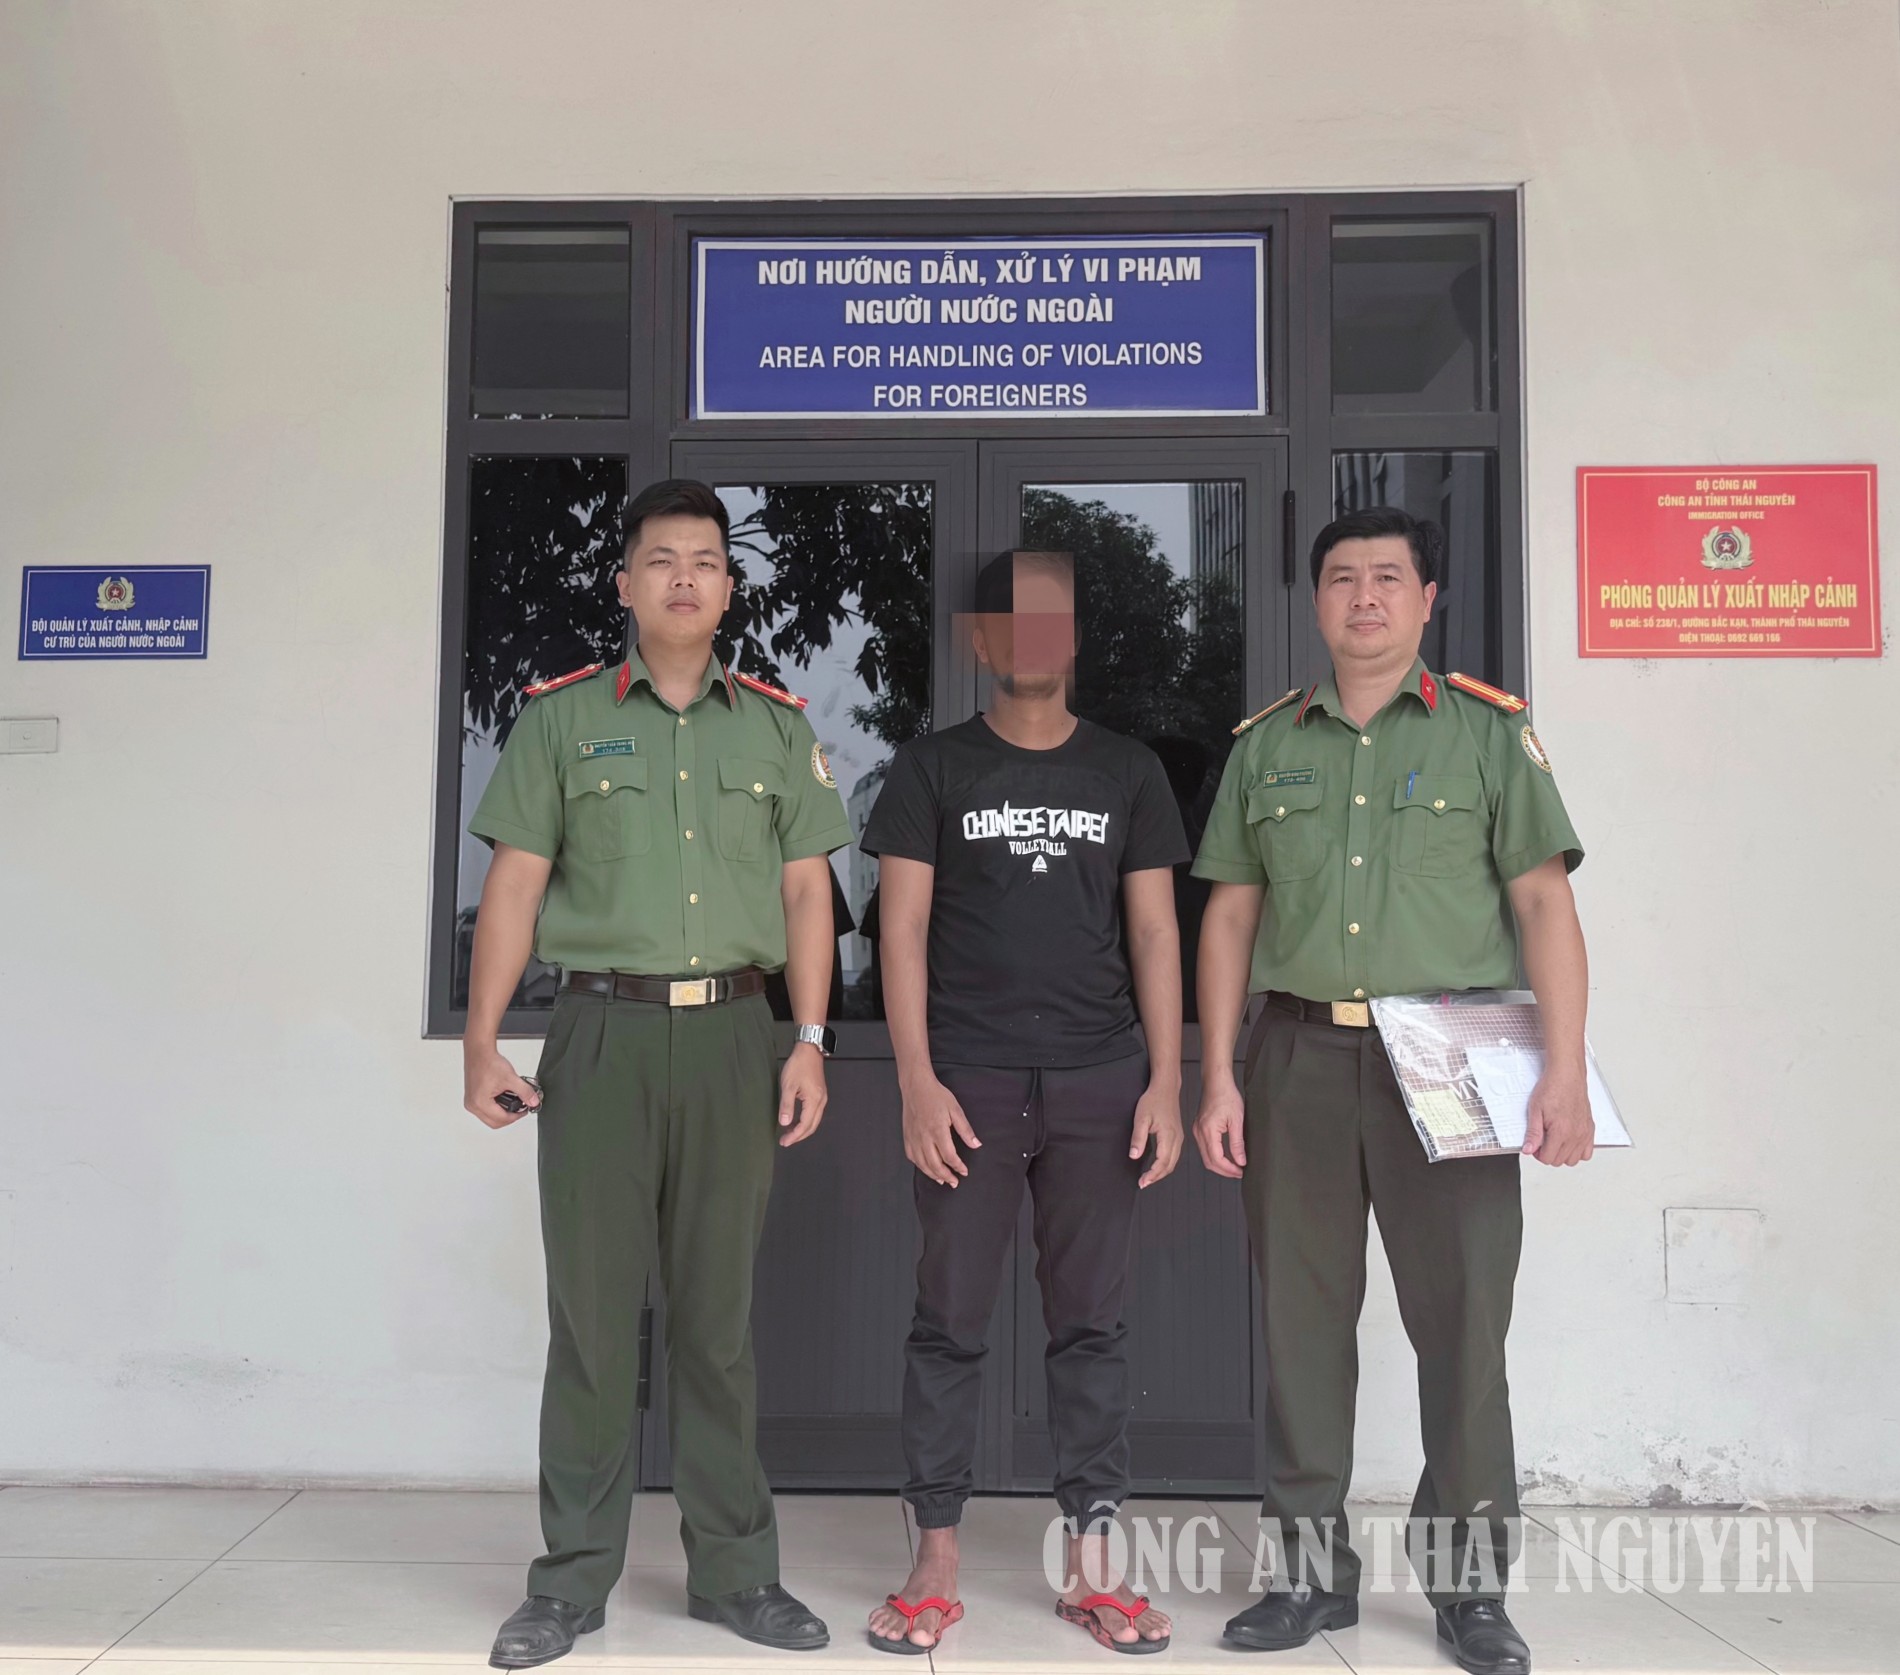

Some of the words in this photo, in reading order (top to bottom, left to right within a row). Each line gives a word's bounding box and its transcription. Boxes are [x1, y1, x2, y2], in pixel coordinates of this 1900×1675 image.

[758, 259, 806, 284] NƠI
[815, 255, 911, 284] HƯỚNG
[920, 251, 987, 287] DẪN,
[996, 251, 1038, 283] XỬ
[1043, 253, 1073, 282] LÝ
[1084, 258, 1108, 282] VI
[1118, 257, 1201, 288] PHẠM
[845, 296, 931, 324] NGƯỜI
[941, 293, 1018, 323] NƯỚC
[1027, 292, 1113, 323] NGOÀI
[759, 346, 824, 368] AREA
[834, 346, 881, 367] FOR
[889, 344, 1013, 367] HANDLING
[1021, 344, 1054, 366] OF
[1060, 342, 1202, 365] VIOLATIONS
[874, 385, 921, 407] FOR
[930, 384, 1087, 407] FOREIGNERS
[1696, 478, 1709, 493] BỘ
[1712, 478, 1740, 491] CÔNG
[1742, 480, 1756, 490] AN
[1658, 495, 1685, 506] CÔNG
[1688, 496, 1704, 506] AN
[1707, 492, 1728, 506] TỈNH
[1730, 493, 1752, 506] THÁI
[1755, 494, 1795, 505] NGUYÊN
[1689, 512, 1737, 520] IMMIGRATION
[1740, 511, 1764, 519] OFFICE
[1601, 580, 1652, 609] PHÒNG
[1657, 577, 1699, 611] QUẢN
[1703, 579, 1721, 608] LÝ
[1725, 576, 1765, 608] XUẤT
[1768, 579, 1810, 613] NHẬP
[1815, 576, 1857, 608] CẢNH
[32, 618, 47, 634] ĐỘI
[50, 616, 74, 632] QUẢN
[77, 618, 88, 631] LÝ
[90, 616, 113, 631] XUẤT
[145, 617, 170, 633] NHẬP
[173, 616, 198, 631] CẢNH
[44, 636, 57, 648] CƯ
[78, 632, 96, 648] CỦA
[99, 633, 127, 648] NGƯỜI
[129, 633, 154, 647] NƯỚC
[157, 634, 185, 647] NGOÀI
